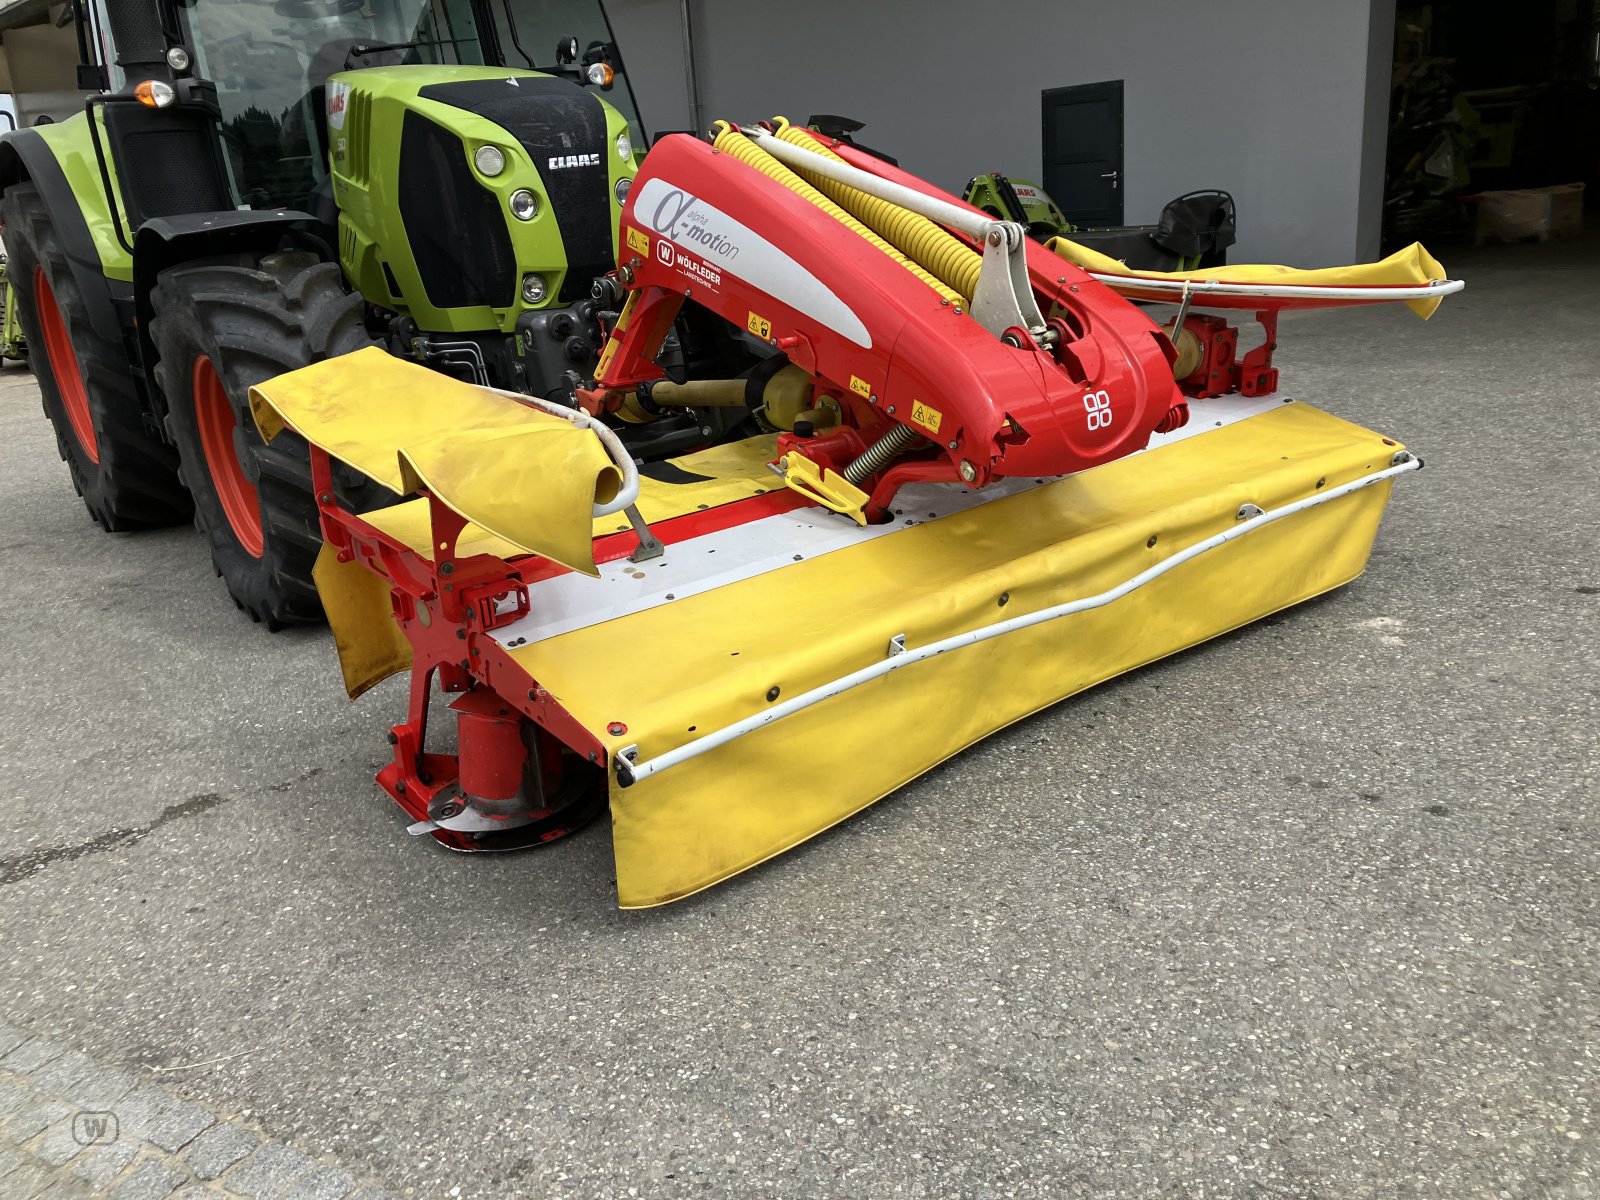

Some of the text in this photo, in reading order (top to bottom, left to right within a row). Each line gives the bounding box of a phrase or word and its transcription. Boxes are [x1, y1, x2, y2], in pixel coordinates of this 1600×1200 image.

[548, 153, 600, 170] CLAAS
[687, 210, 709, 226] alpha
[677, 254, 720, 285] WÖLFLEDER
